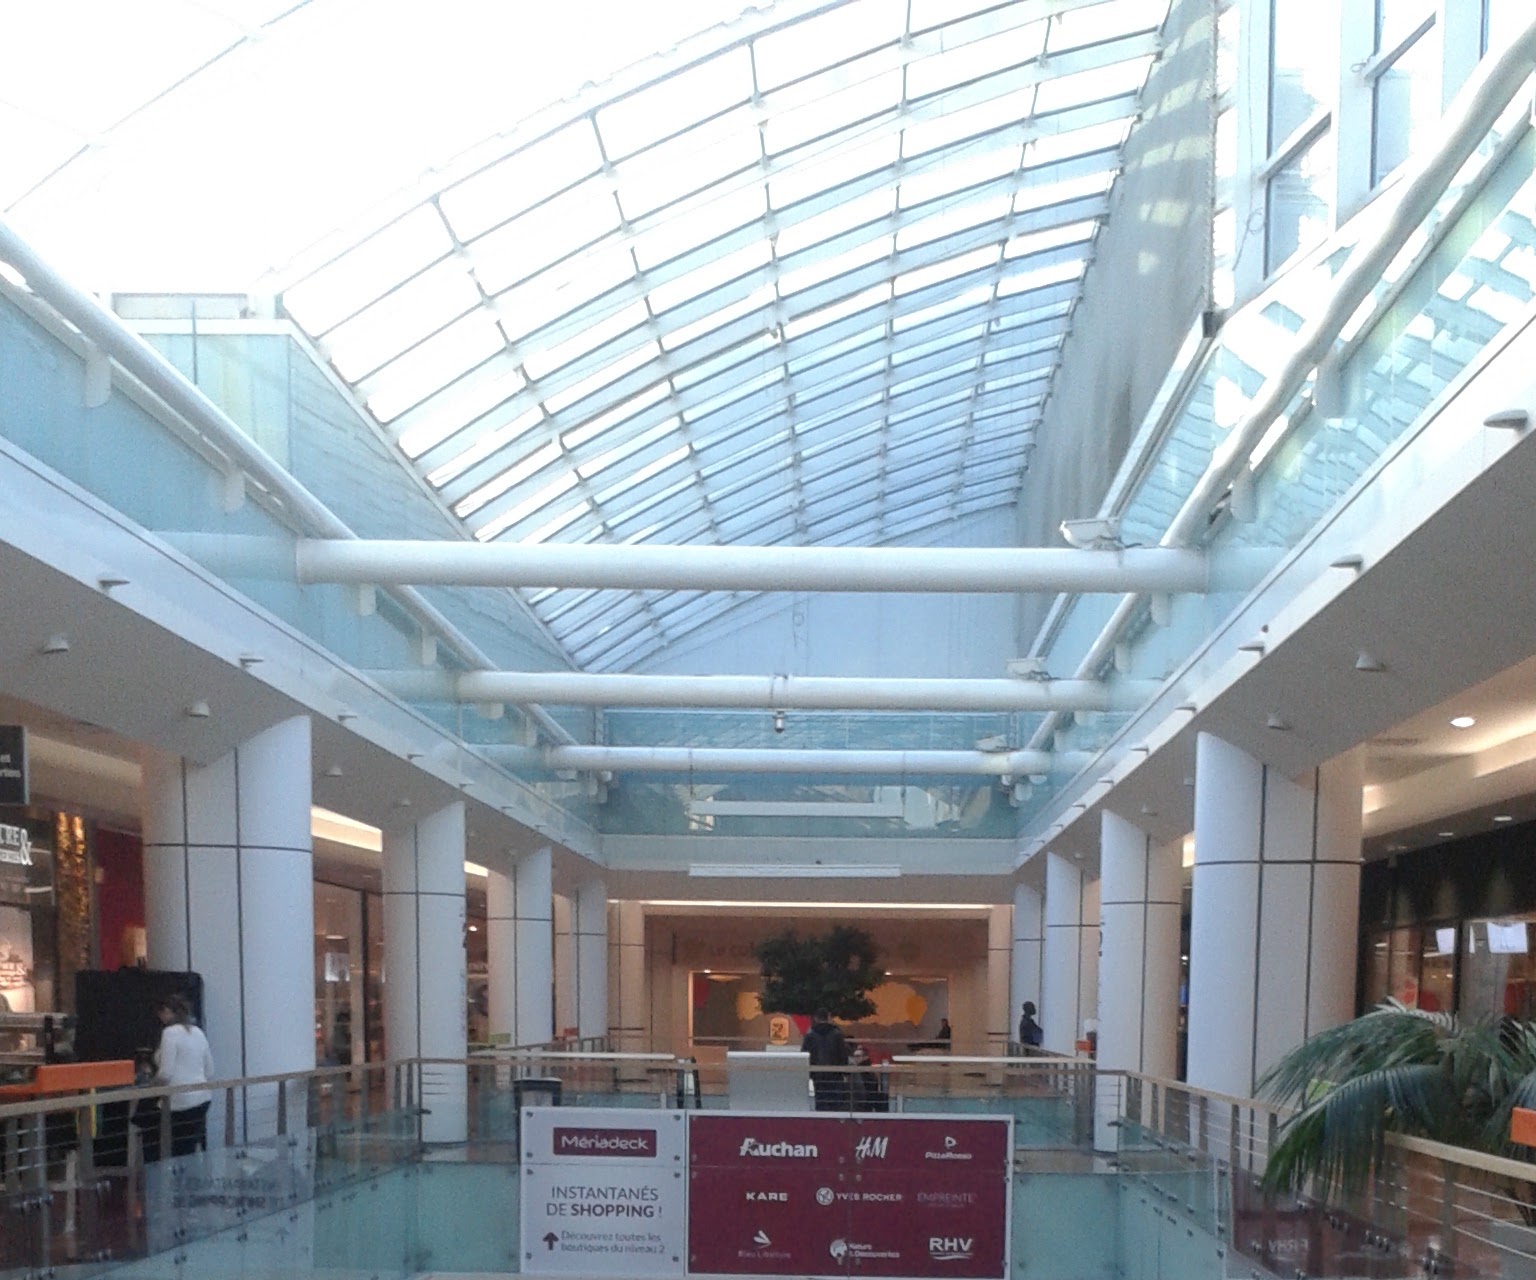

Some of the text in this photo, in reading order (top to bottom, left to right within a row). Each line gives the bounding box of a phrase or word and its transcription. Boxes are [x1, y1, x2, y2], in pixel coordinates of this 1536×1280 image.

[561, 1134, 649, 1150] Mériadeck
[739, 1137, 818, 1158] Auchan
[855, 1136, 889, 1159] H&M
[551, 1185, 659, 1202] INSTANTANÉS
[745, 1191, 788, 1202] KARE
[836, 1192, 903, 1202] YVES ROCHER
[546, 1203, 568, 1216] DE
[570, 1203, 655, 1218] SHOPPING
[615, 1232, 646, 1242] toutes
[647, 1232, 661, 1242] les
[929, 1236, 974, 1252] RHV
[560, 1243, 666, 1254] boutiques du niveau 2
